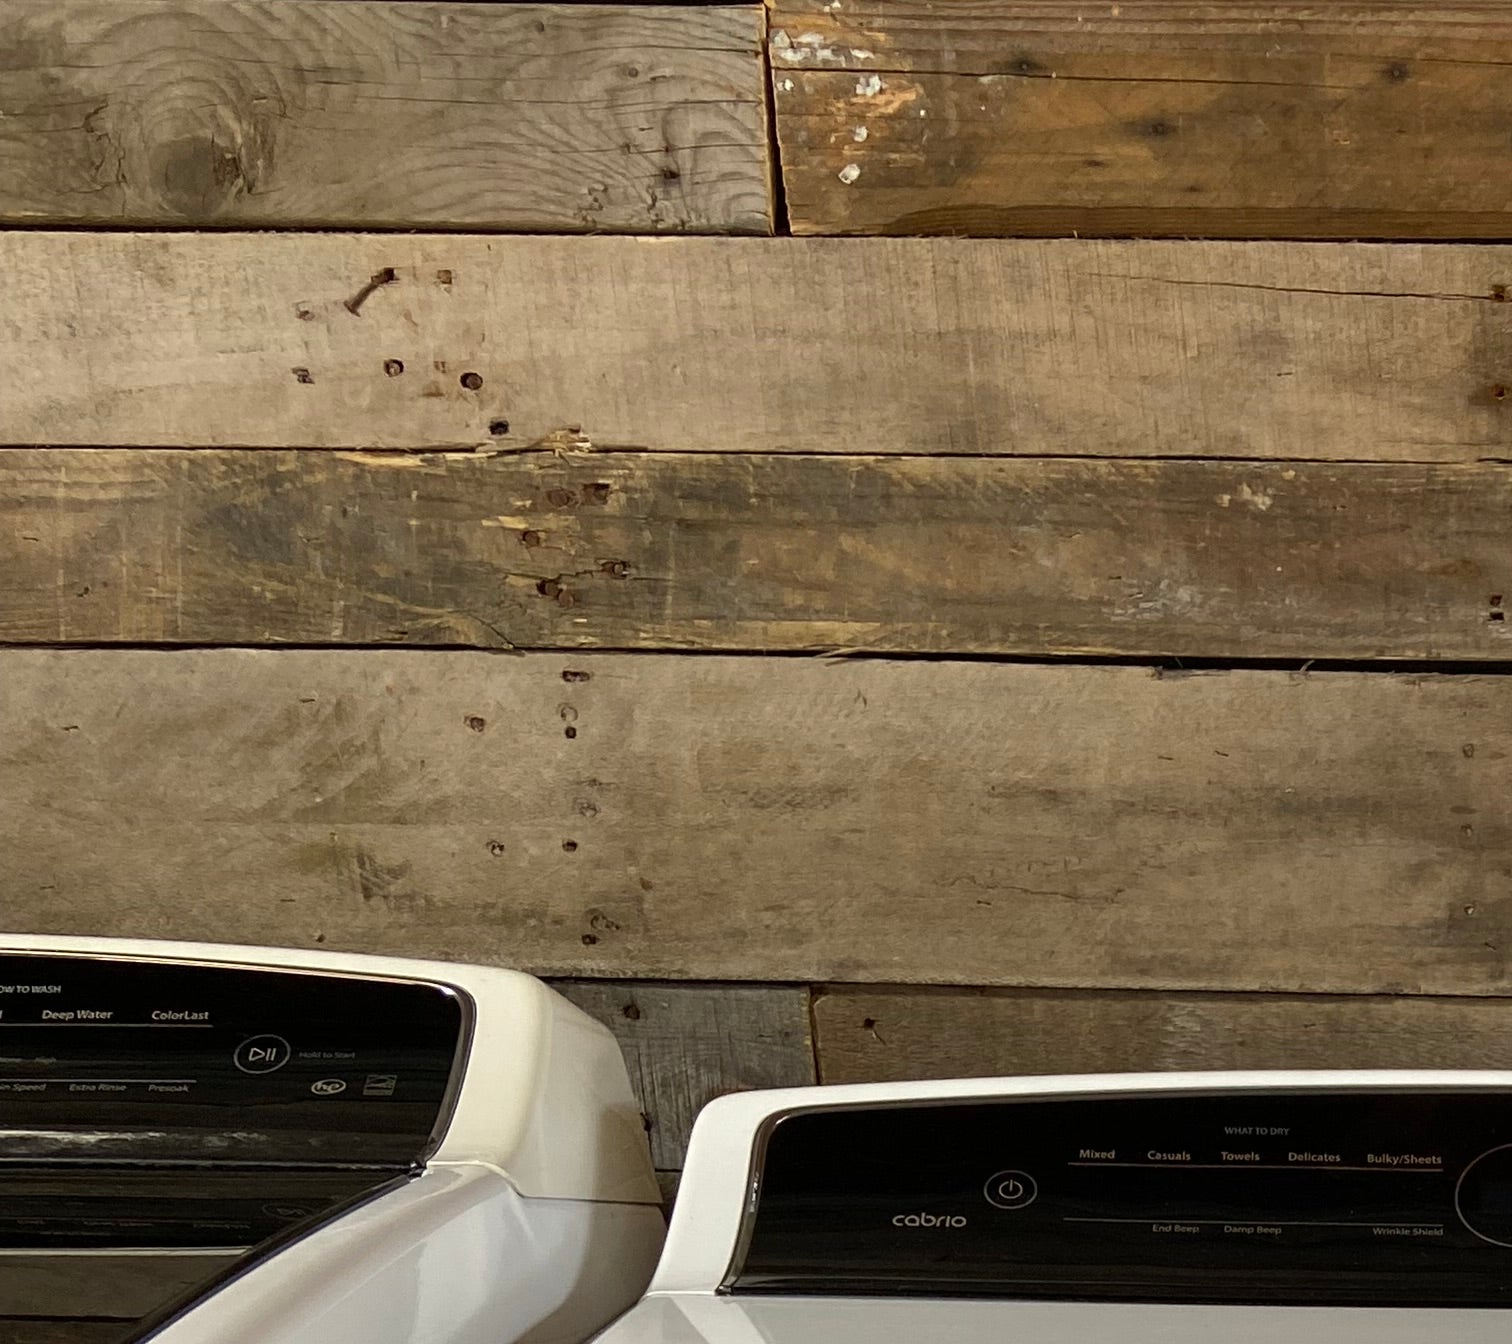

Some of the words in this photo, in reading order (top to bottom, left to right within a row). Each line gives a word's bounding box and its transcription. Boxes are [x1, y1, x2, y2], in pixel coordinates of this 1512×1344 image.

[31, 985, 62, 994] WASH
[41, 1009, 75, 1022] Deep
[77, 1009, 113, 1020] Water
[151, 1010, 209, 1021] ColorLast
[1224, 1127, 1253, 1136] WHAT
[1254, 1127, 1269, 1136] TO
[1270, 1127, 1290, 1136] DRY
[1079, 1148, 1116, 1160] Mixed
[1147, 1150, 1191, 1162] Casuals
[1221, 1151, 1260, 1162] Towels
[1288, 1152, 1341, 1163] Delicates
[1367, 1153, 1442, 1166] Bulky/Sheets
[892, 1212, 967, 1228] cabrio
[1152, 1224, 1172, 1233] End
[1174, 1224, 1200, 1235] Beep
[1224, 1225, 1254, 1235] Damp
[1256, 1225, 1282, 1236] Beep
[1372, 1227, 1411, 1236] Wrinkle
[1412, 1227, 1444, 1237] Shield
